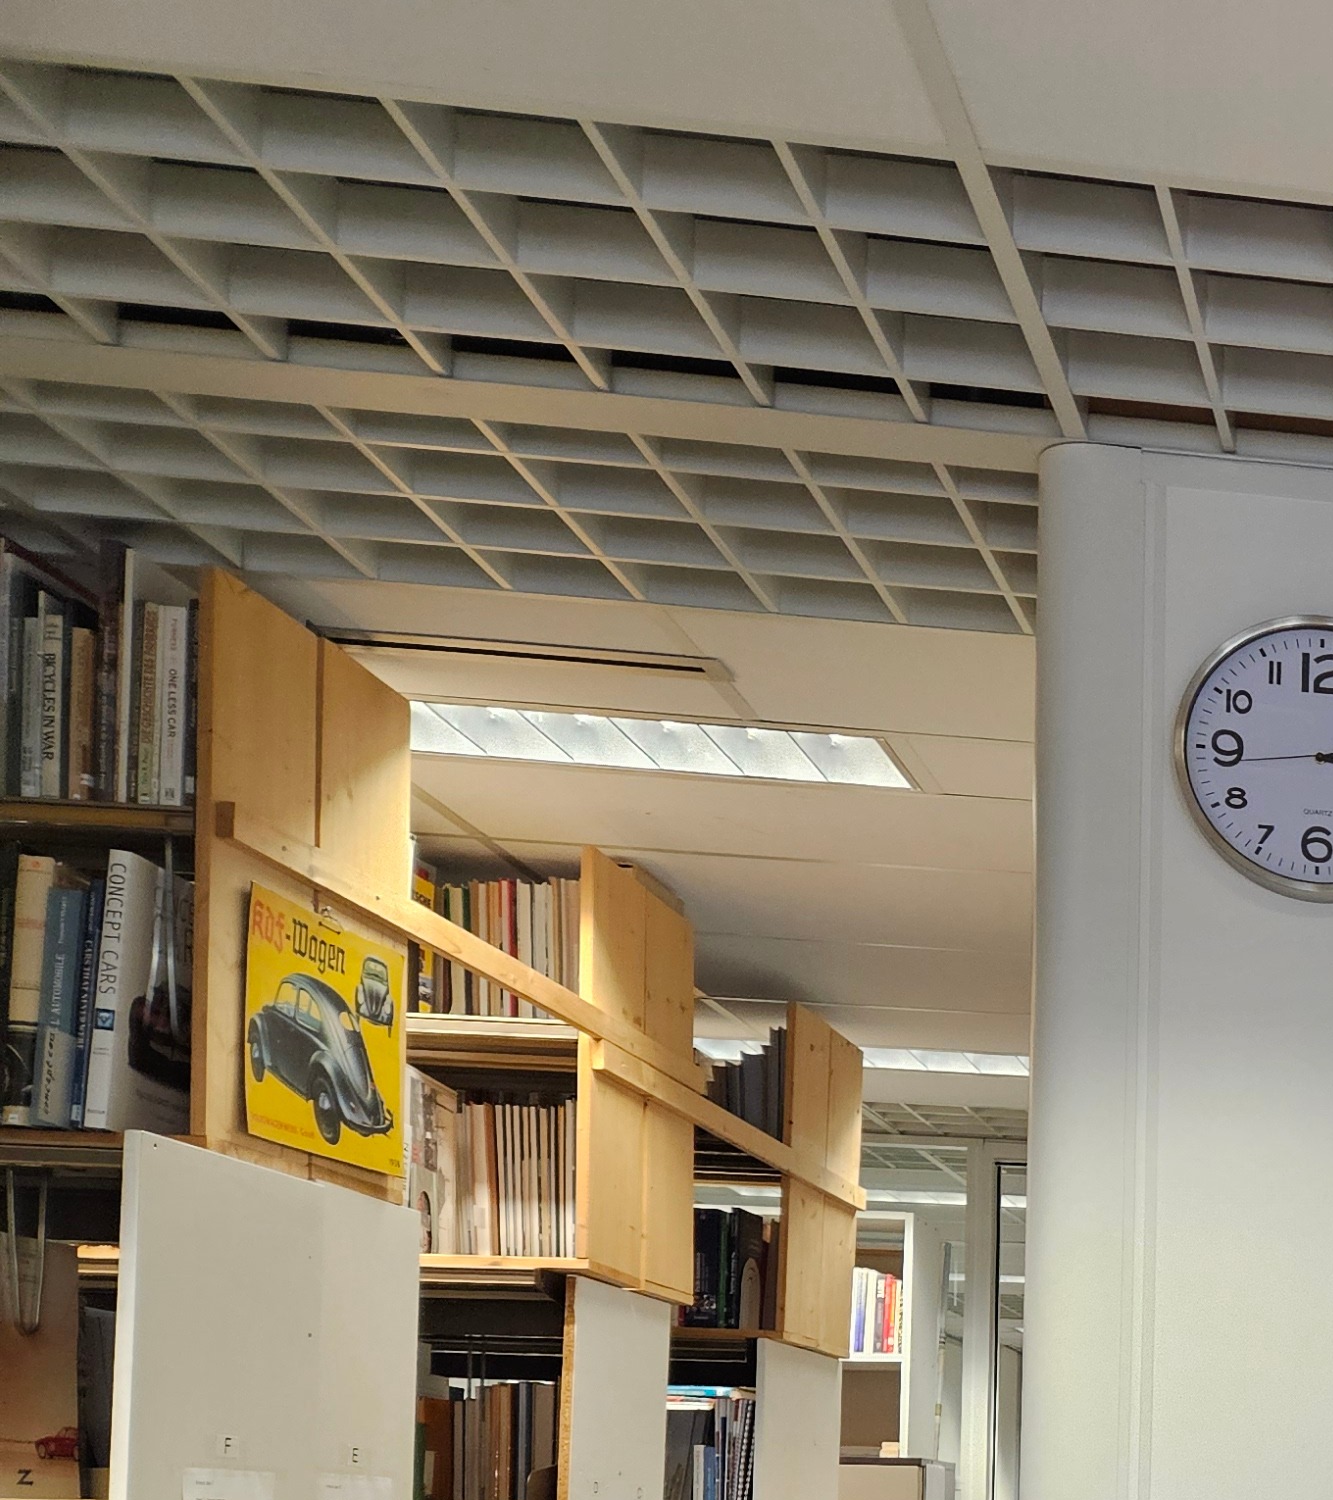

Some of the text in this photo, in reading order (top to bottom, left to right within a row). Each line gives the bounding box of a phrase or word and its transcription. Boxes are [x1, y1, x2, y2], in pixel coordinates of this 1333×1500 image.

[42, 653, 56, 710] BICYCLES
[1268, 660, 1282, 685] 11
[168, 668, 178, 738] ONE LESS CAR
[1225, 688, 1252, 714] 10
[41, 724, 54, 760] WAR
[1211, 729, 1244, 767] 9
[1224, 787, 1248, 809] 8
[1303, 808, 1333, 817] QUARTZ
[1258, 824, 1274, 844] 7
[1301, 826, 1333, 863] 6
[100, 862, 126, 995] CONCEPT CARS
[224, 1437, 232, 1454] F
[352, 1447, 359, 1463] E
